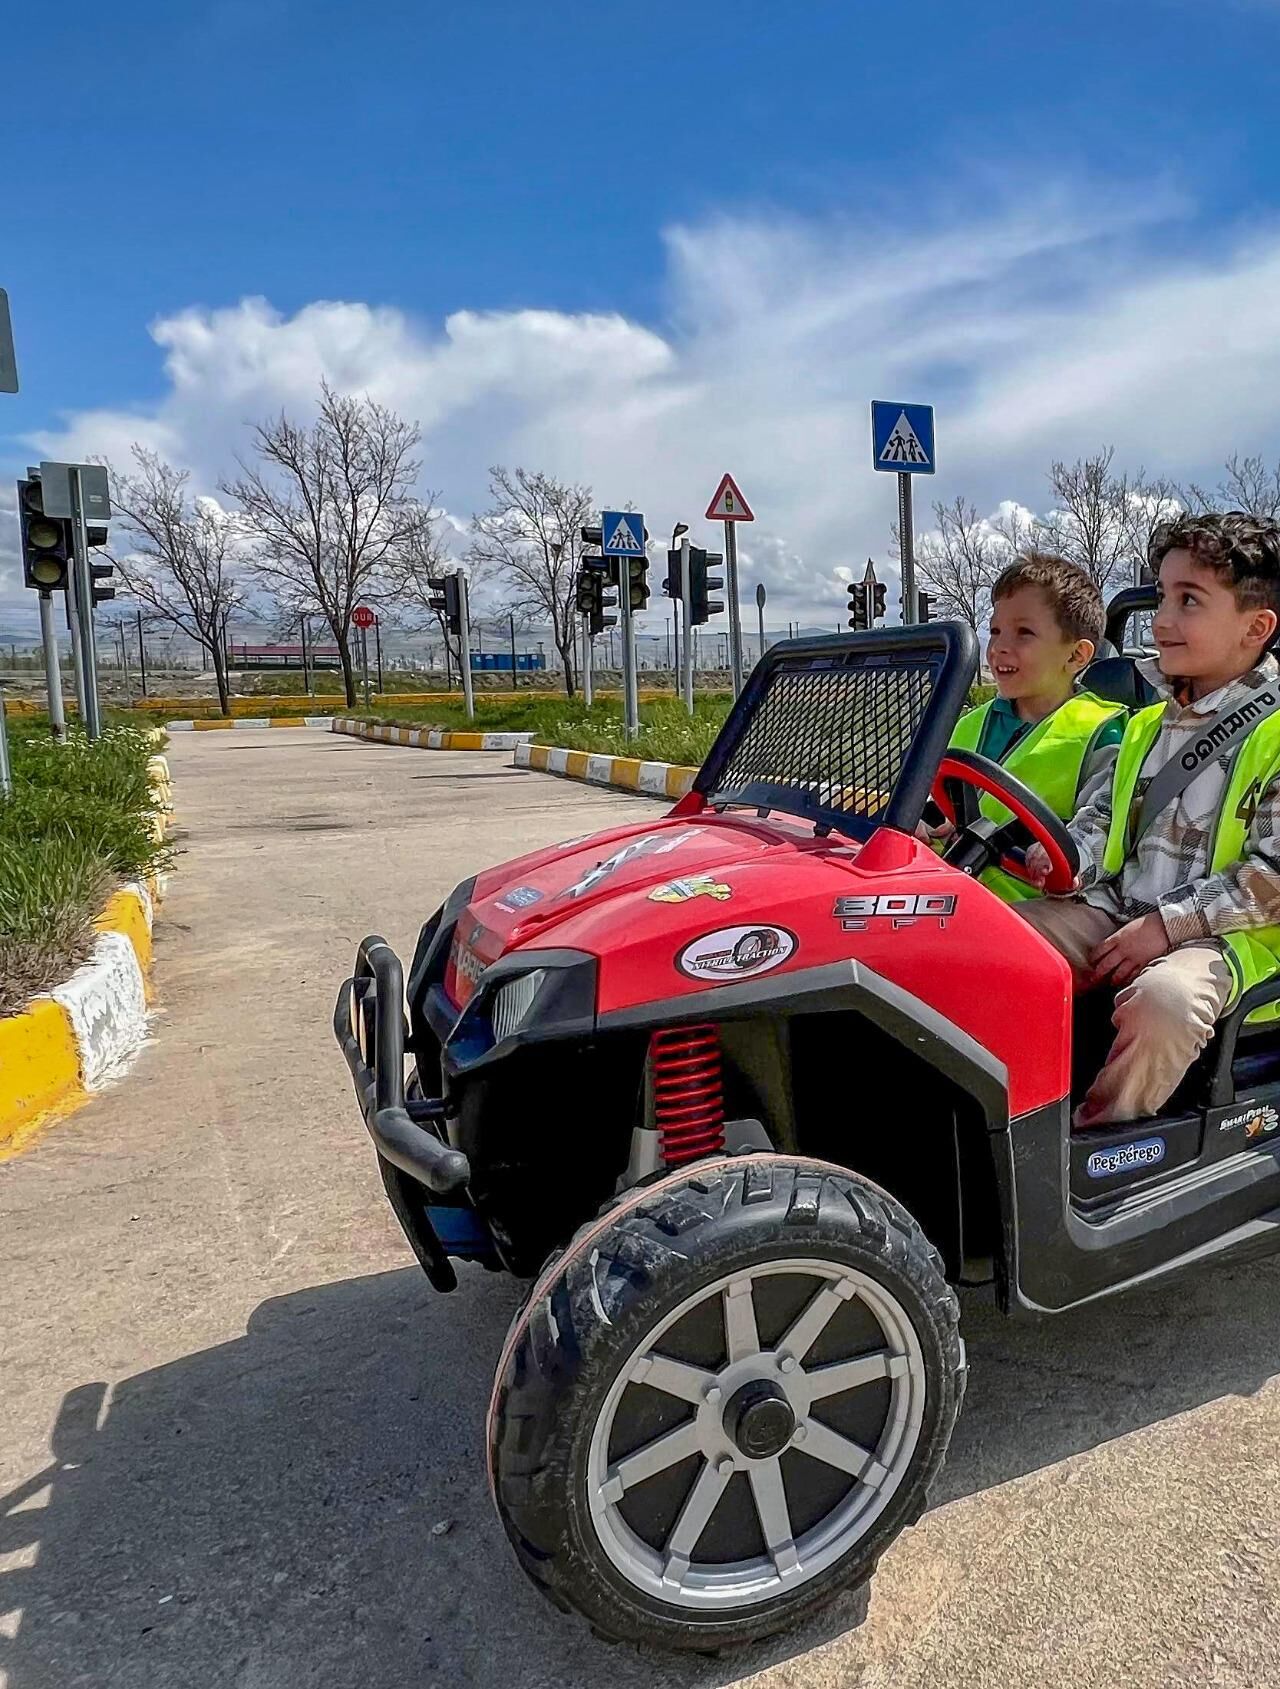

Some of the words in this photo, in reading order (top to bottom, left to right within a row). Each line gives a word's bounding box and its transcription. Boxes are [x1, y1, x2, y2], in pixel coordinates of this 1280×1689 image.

[353, 613, 372, 622] DUR
[1181, 691, 1276, 772] PEREGO
[832, 894, 958, 918] 800
[736, 945, 789, 963] TRACTION
